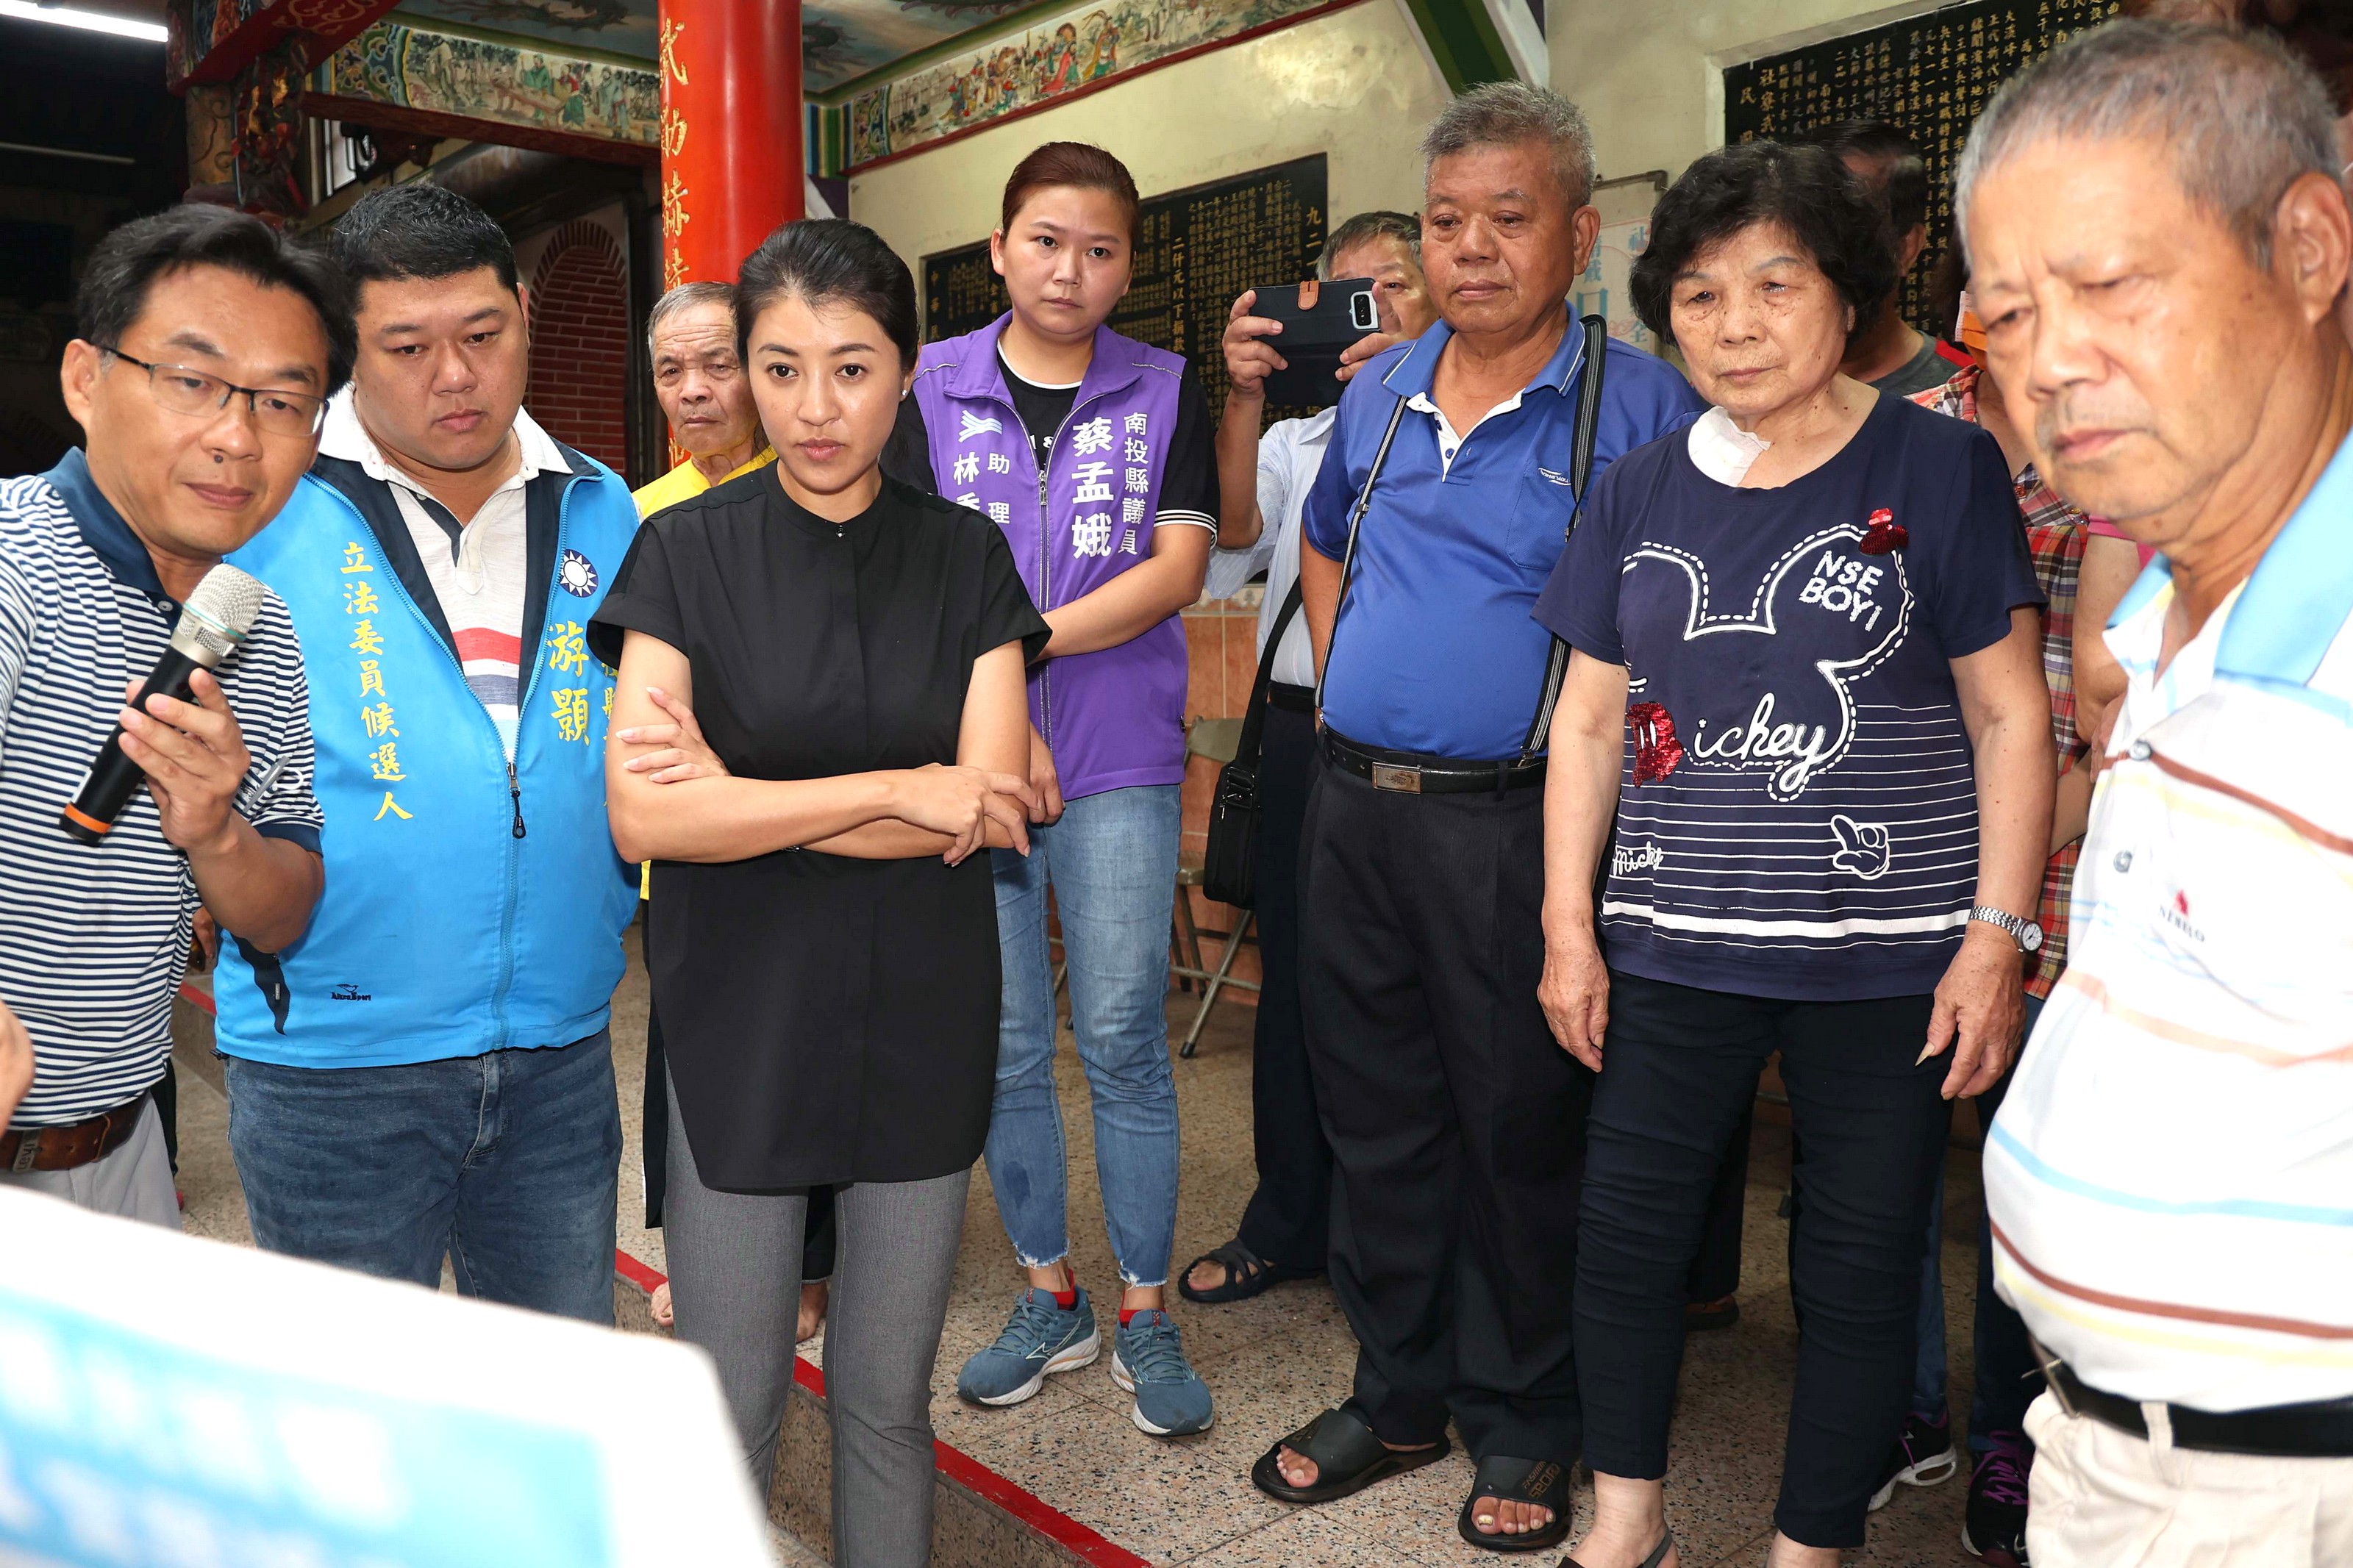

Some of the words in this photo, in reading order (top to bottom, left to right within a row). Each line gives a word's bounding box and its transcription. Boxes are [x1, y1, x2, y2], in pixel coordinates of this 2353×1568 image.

[1759, 68, 1777, 141] 社寮武
[987, 453, 1010, 525] 助理
[1071, 416, 1114, 559] 蔡孟娥
[1118, 412, 1149, 556] 南投縣議員
[1813, 551, 1883, 595] NSE
[340, 542, 413, 821] 立法委員候選人
